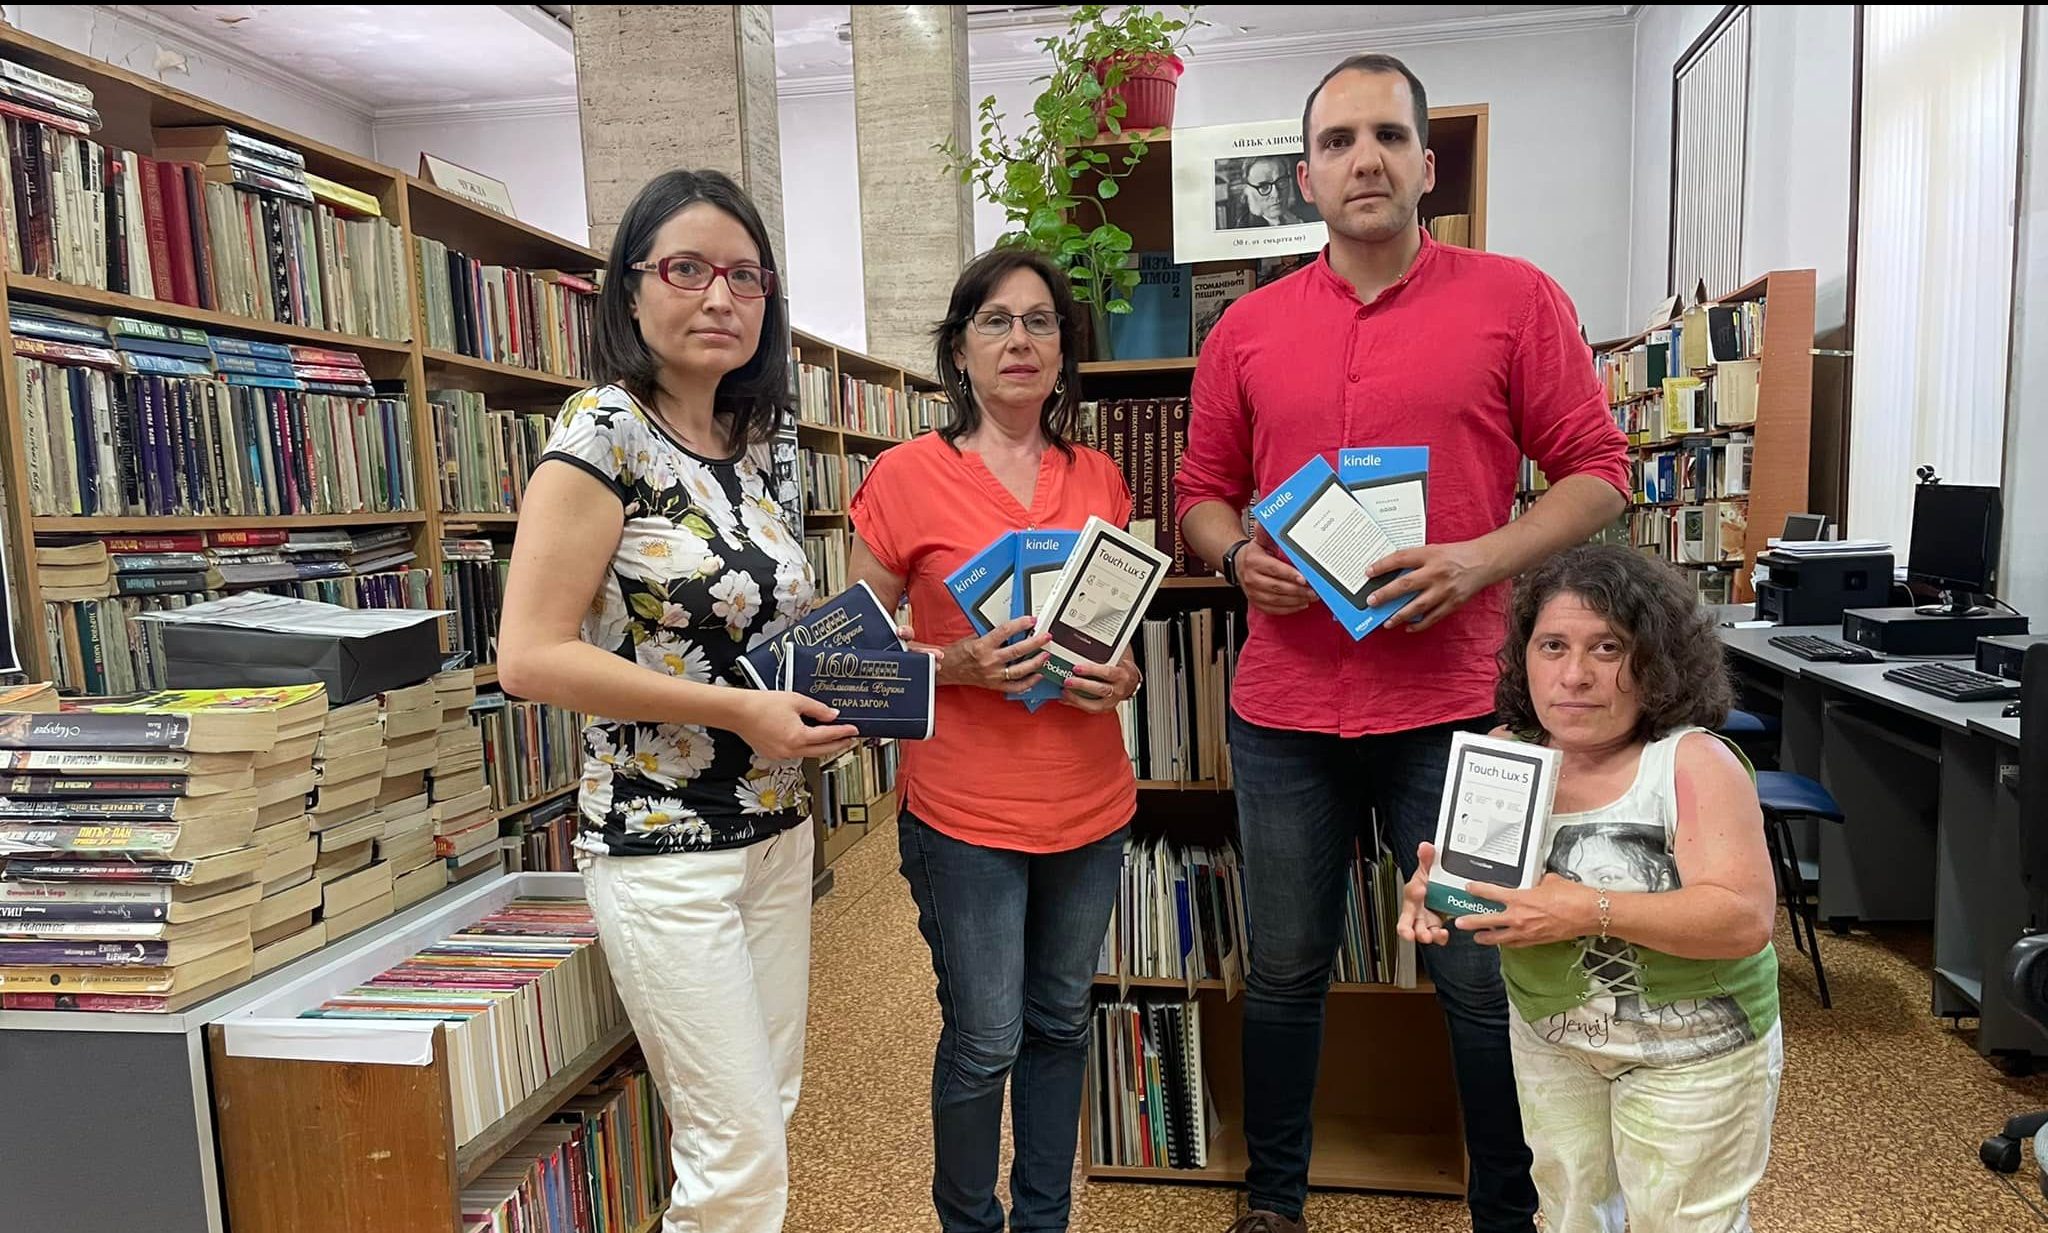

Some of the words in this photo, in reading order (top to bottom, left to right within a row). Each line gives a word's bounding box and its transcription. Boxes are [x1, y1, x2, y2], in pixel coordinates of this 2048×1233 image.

[1232, 138, 1263, 148] АЙЗЪК
[1172, 286, 1180, 298] 2
[1195, 279, 1244, 290] СТОМАНЕНИТЕ
[1195, 290, 1226, 299] ПЕЩЕРИ
[1113, 406, 1124, 421] 6
[1145, 405, 1154, 420] 5
[1173, 405, 1184, 420] 6
[1143, 432, 1153, 494] БЪЛГАРИЯ
[1344, 454, 1382, 466] kindle
[1143, 495, 1153, 515] НА
[1260, 490, 1294, 520] kindle
[1025, 538, 1060, 551] kindle
[1099, 548, 1123, 568] Touch
[1123, 561, 1140, 577] Lux
[1139, 570, 1146, 580] 5
[954, 566, 987, 593] kindle
[814, 651, 859, 677] 160
[1043, 660, 1073, 678] PocketB
[871, 681, 905, 697] Родина
[832, 698, 859, 708] СТАРА
[860, 698, 889, 708] ЗАГОРА
[1468, 762, 1499, 778] Touch
[1501, 769, 1520, 782] Lux
[1522, 773, 1529, 783] 5
[78, 826, 112, 838] ПИТЪР
[112, 826, 132, 838] ПАН
[0, 907, 23, 917] ПИЛ
[1447, 895, 1497, 915] PocketBoo
